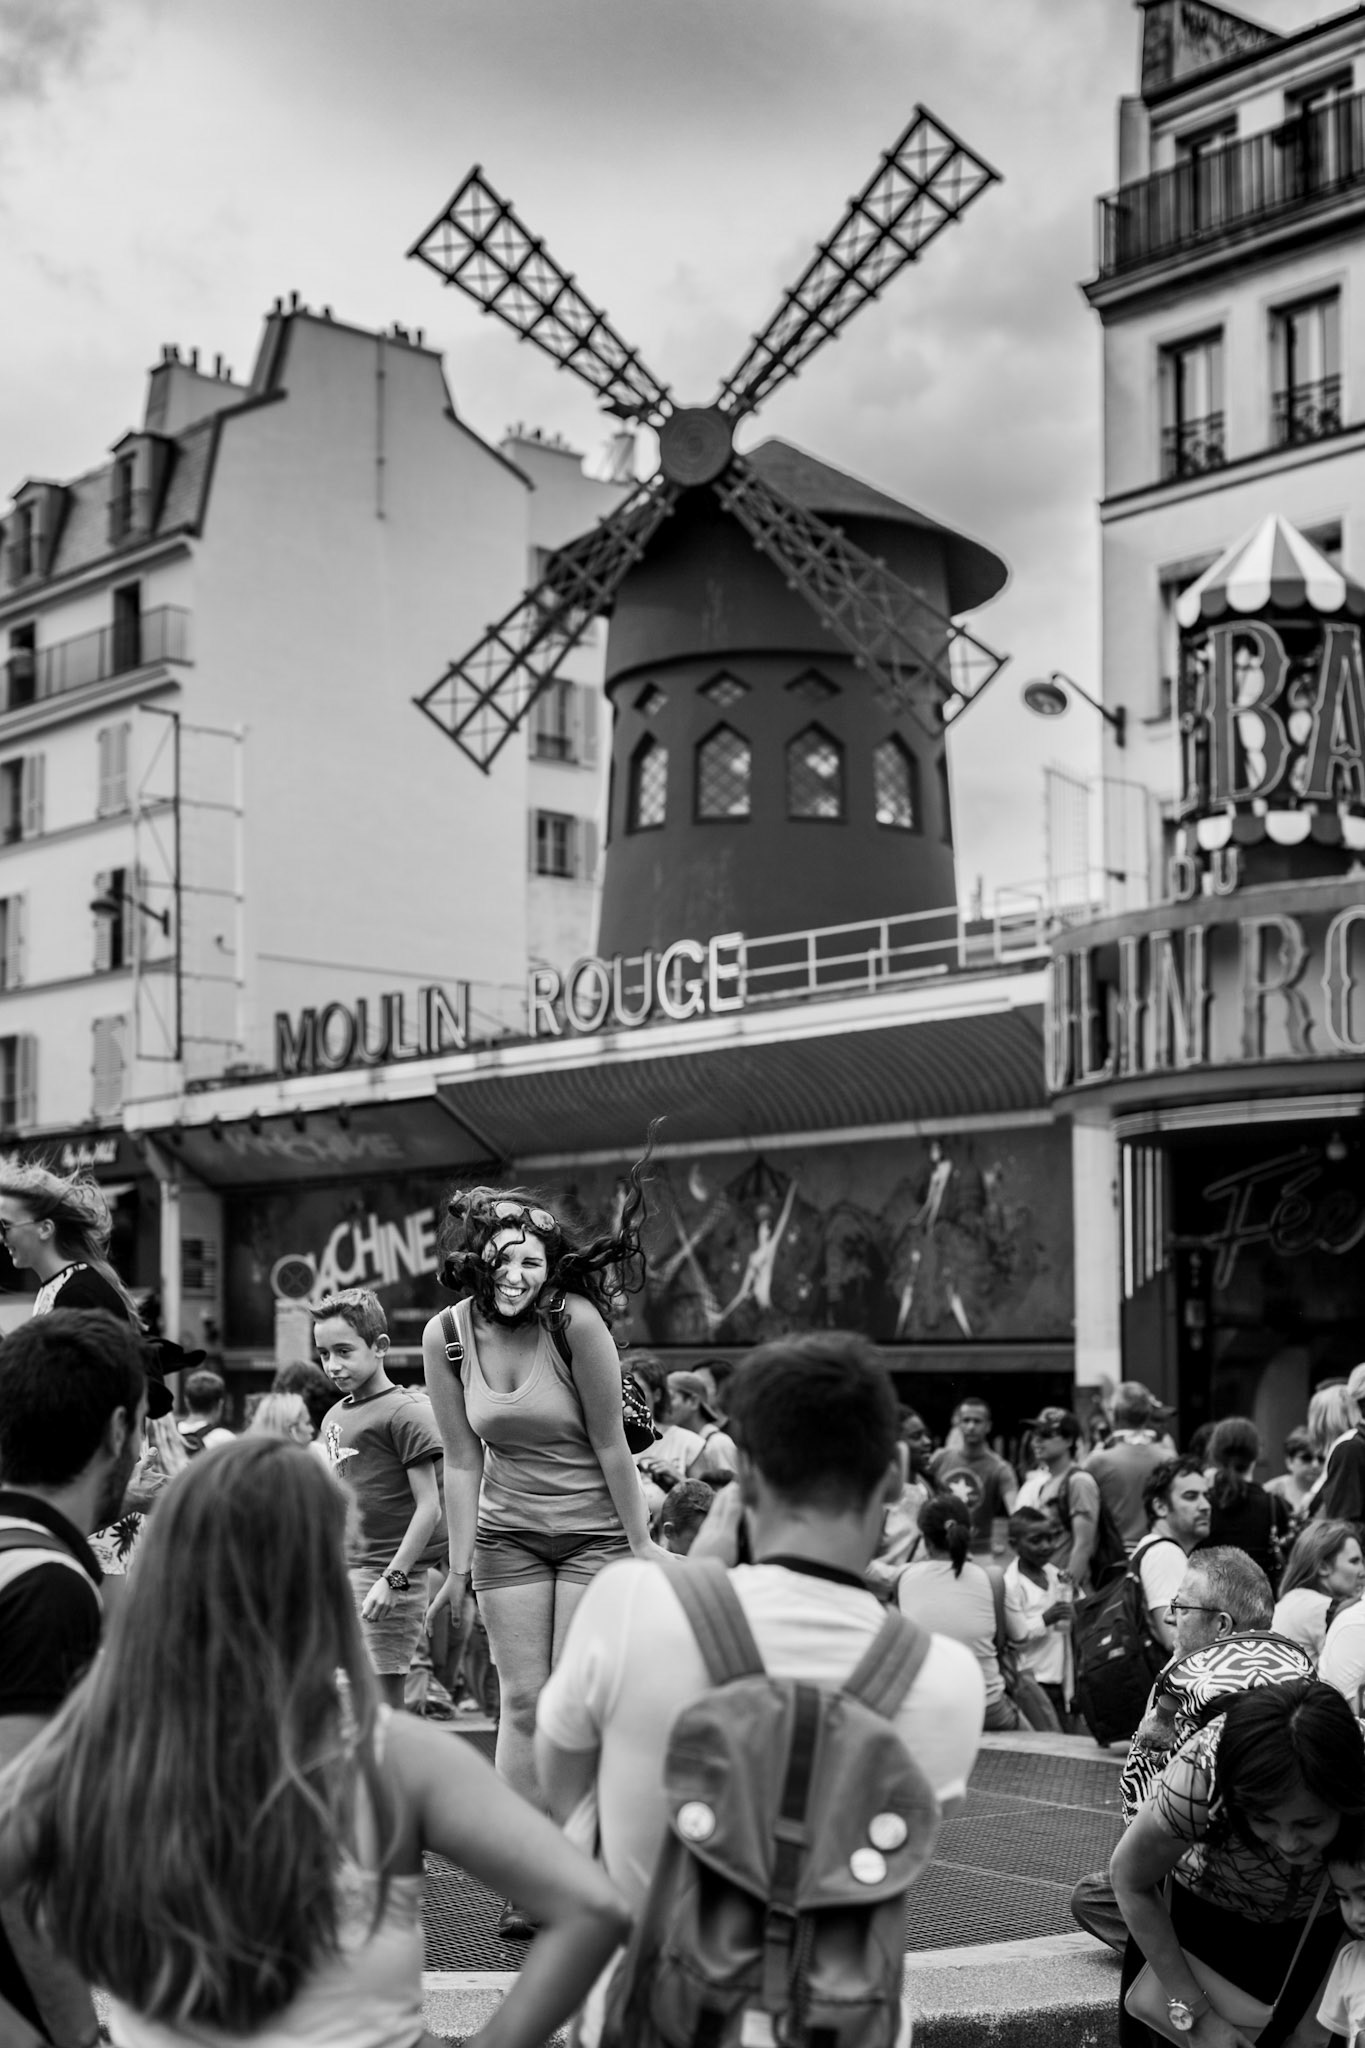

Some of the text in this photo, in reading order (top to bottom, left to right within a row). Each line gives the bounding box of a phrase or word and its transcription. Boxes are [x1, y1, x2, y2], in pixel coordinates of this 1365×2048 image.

[1168, 846, 1238, 901] DU
[274, 931, 746, 1077] MOULIN ROUGE
